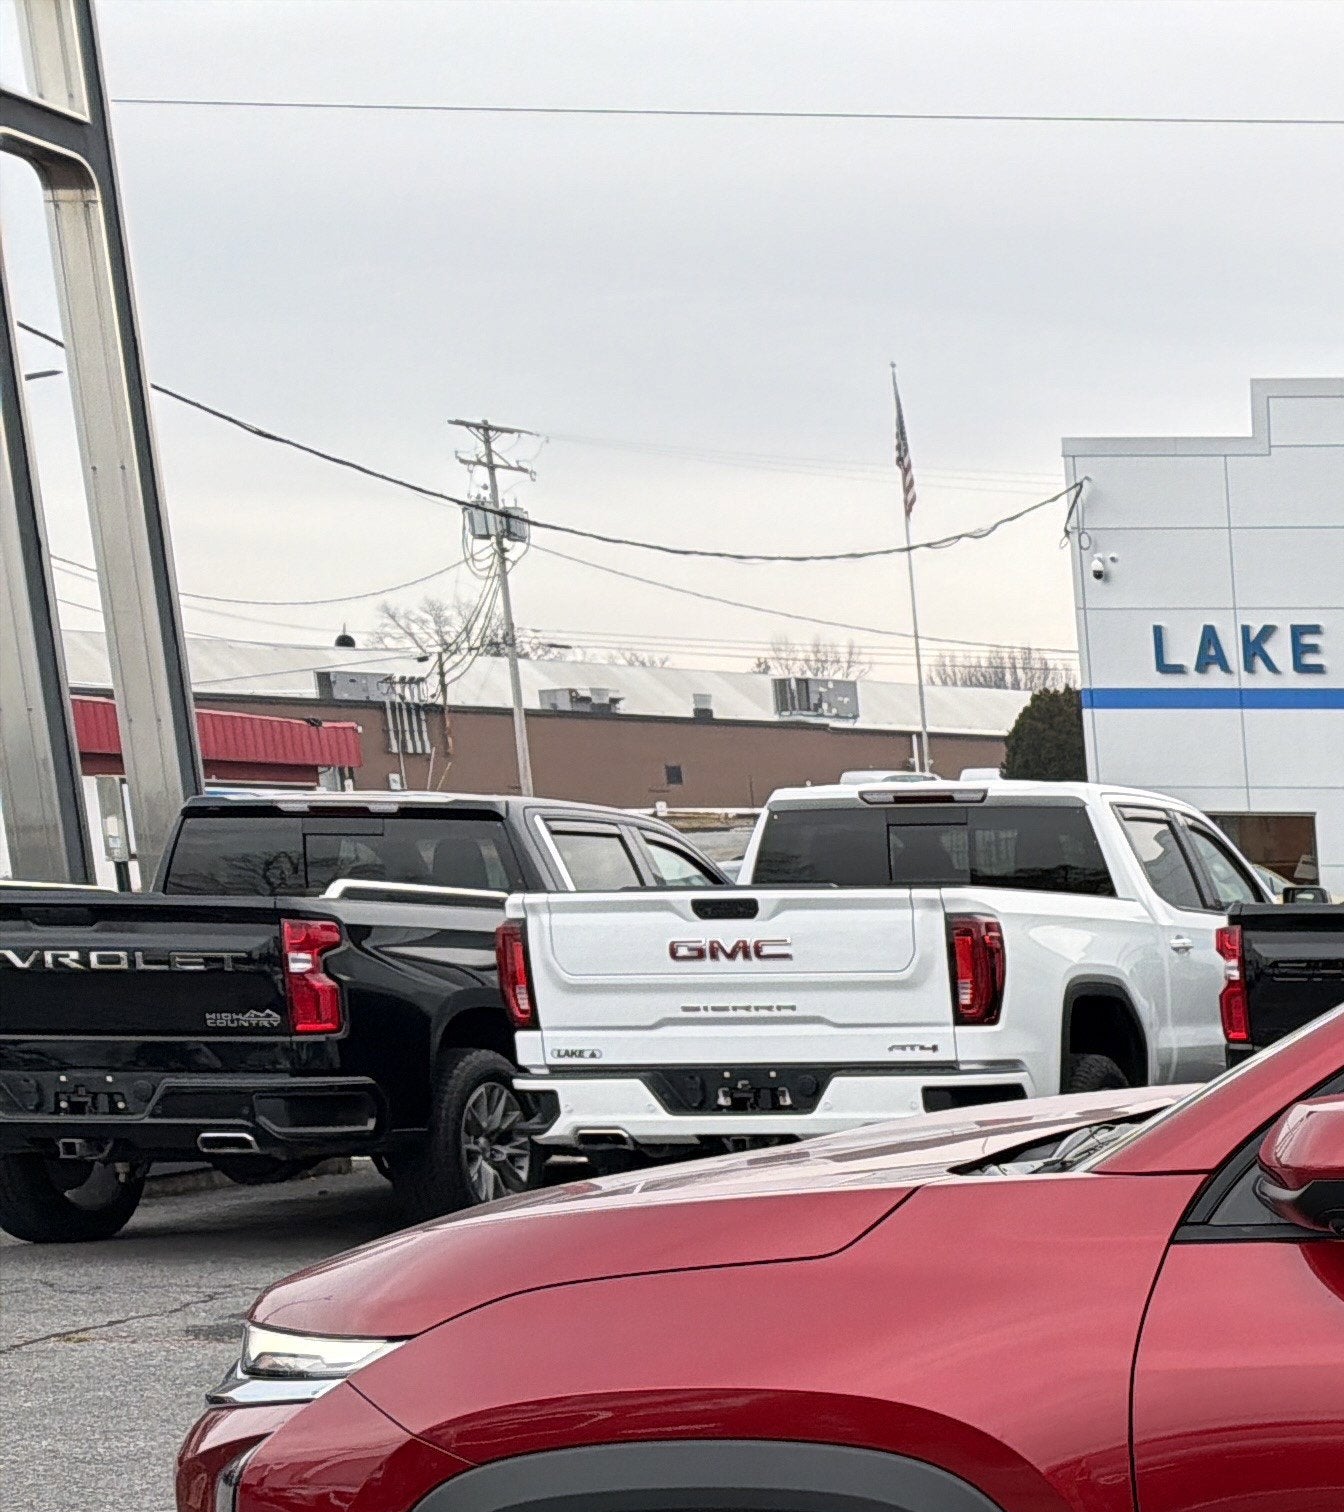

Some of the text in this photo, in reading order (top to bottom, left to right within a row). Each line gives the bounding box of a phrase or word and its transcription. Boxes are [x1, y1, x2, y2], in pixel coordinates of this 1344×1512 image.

[1152, 624, 1327, 674] LAKE
[669, 938, 793, 962] GMC
[680, 1004, 797, 1013] SIERRA
[206, 1019, 280, 1028] COUNTRY
[556, 1049, 586, 1058] LAKE
